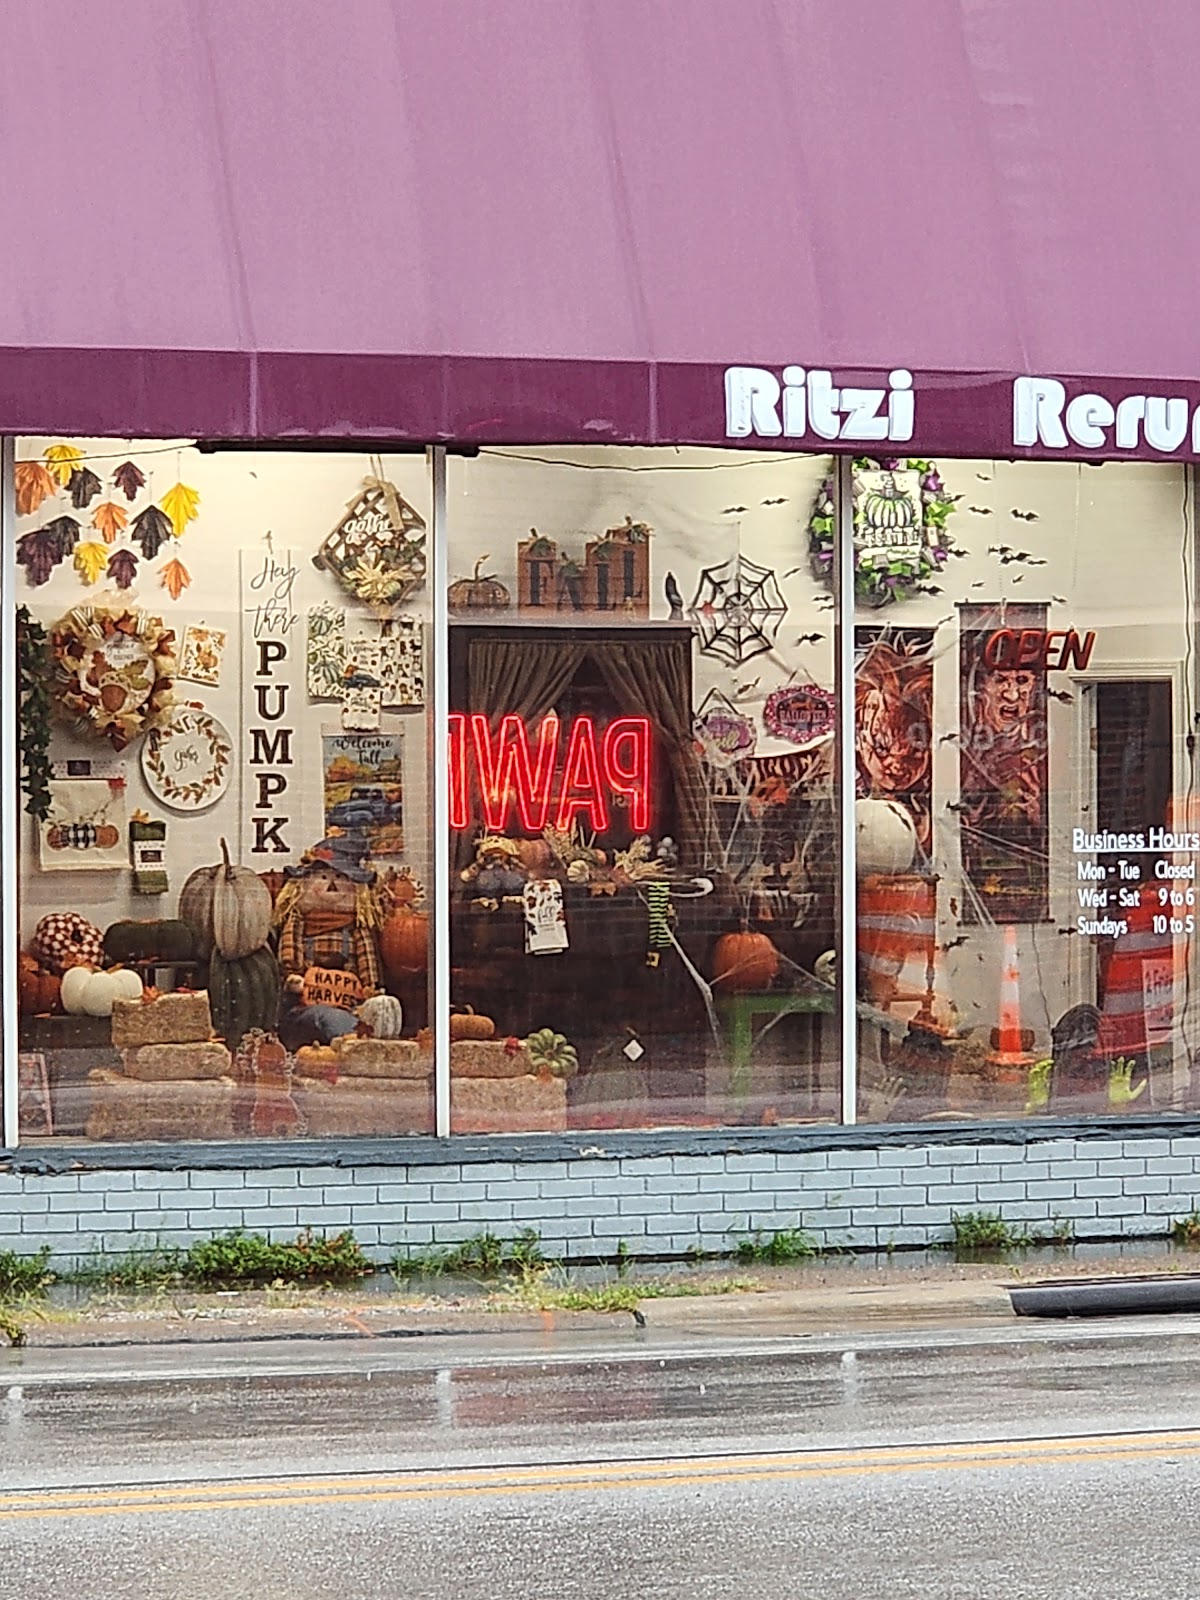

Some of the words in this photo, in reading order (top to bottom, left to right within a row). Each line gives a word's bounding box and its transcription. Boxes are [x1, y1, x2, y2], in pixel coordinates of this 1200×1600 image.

[724, 366, 915, 441] Ritzi
[1013, 376, 1200, 453] Reru
[250, 557, 300, 599] Hey
[525, 550, 645, 612] FALL
[985, 629, 1096, 671] OPEN
[250, 640, 294, 853] PUMPK
[1073, 827, 1146, 852] Business
[1149, 826, 1200, 851] Hours
[1077, 861, 1106, 880] Mon
[1118, 860, 1140, 880] Tue
[1154, 860, 1195, 879] Closed
[1077, 888, 1107, 907] Wed
[1119, 888, 1140, 907] Sat
[1158, 887, 1168, 907] 9
[1170, 890, 1184, 907] to
[1185, 888, 1195, 906] 6
[1077, 916, 1128, 939] Sundays
[1152, 915, 1167, 934] 10
[1170, 917, 1184, 934] to
[1185, 915, 1195, 934] 5
